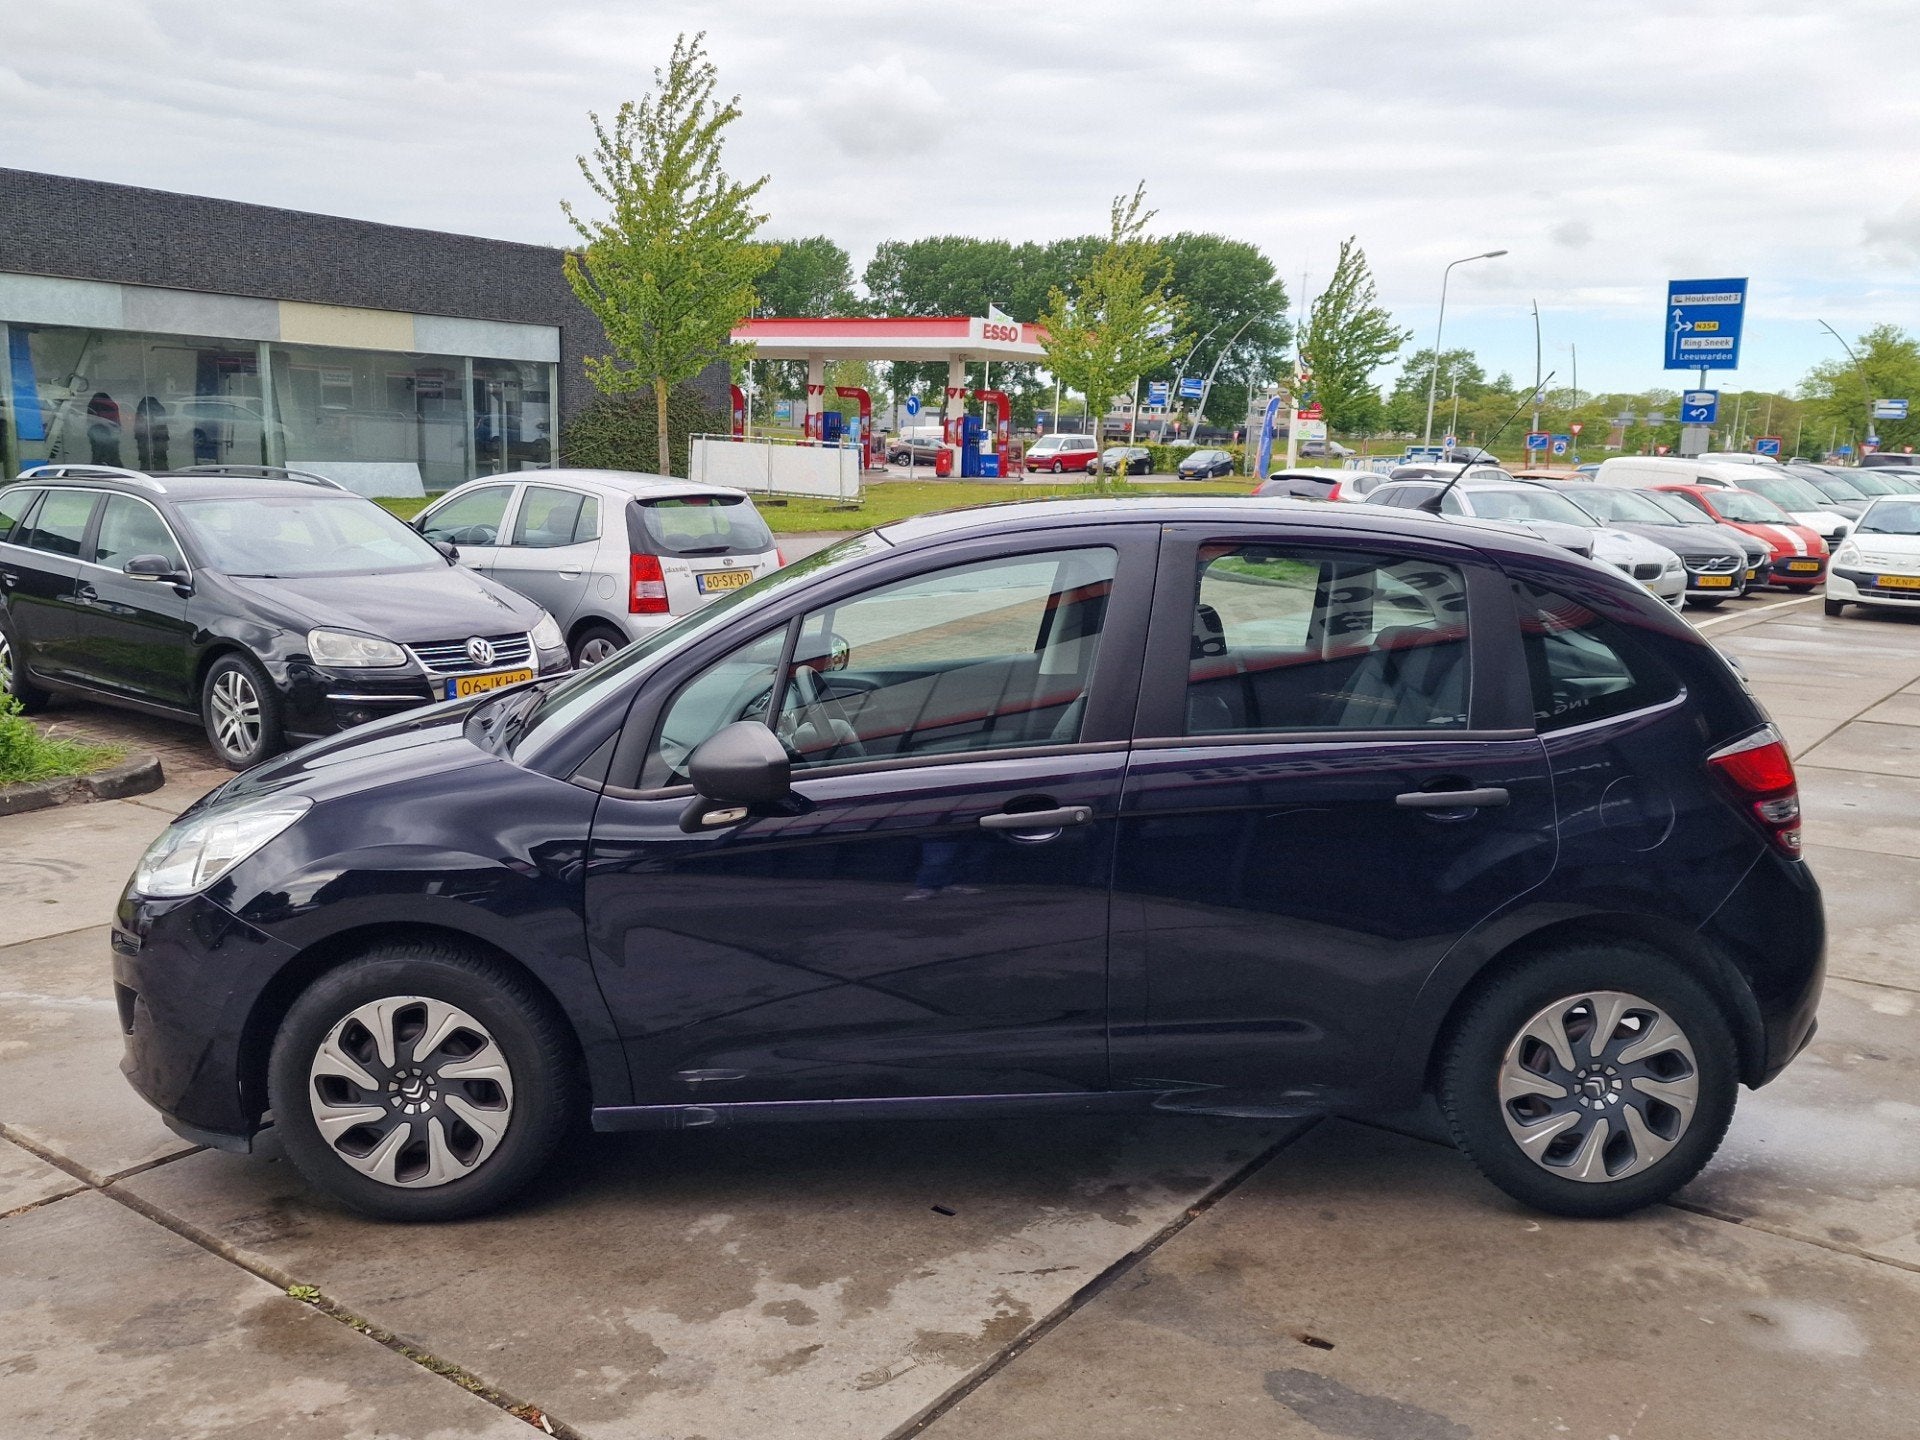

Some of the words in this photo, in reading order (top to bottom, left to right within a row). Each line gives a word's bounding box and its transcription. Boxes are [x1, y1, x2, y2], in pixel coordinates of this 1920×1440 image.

[1685, 293, 1732, 303] Houkesloot
[1695, 322, 1717, 330] N354
[983, 323, 1018, 342] ESSO
[1684, 339, 1702, 348] Ring
[1704, 338, 1730, 346] Sneek
[1679, 352, 1733, 361] Leeuwarden
[706, 573, 751, 588] 60-SX-DP
